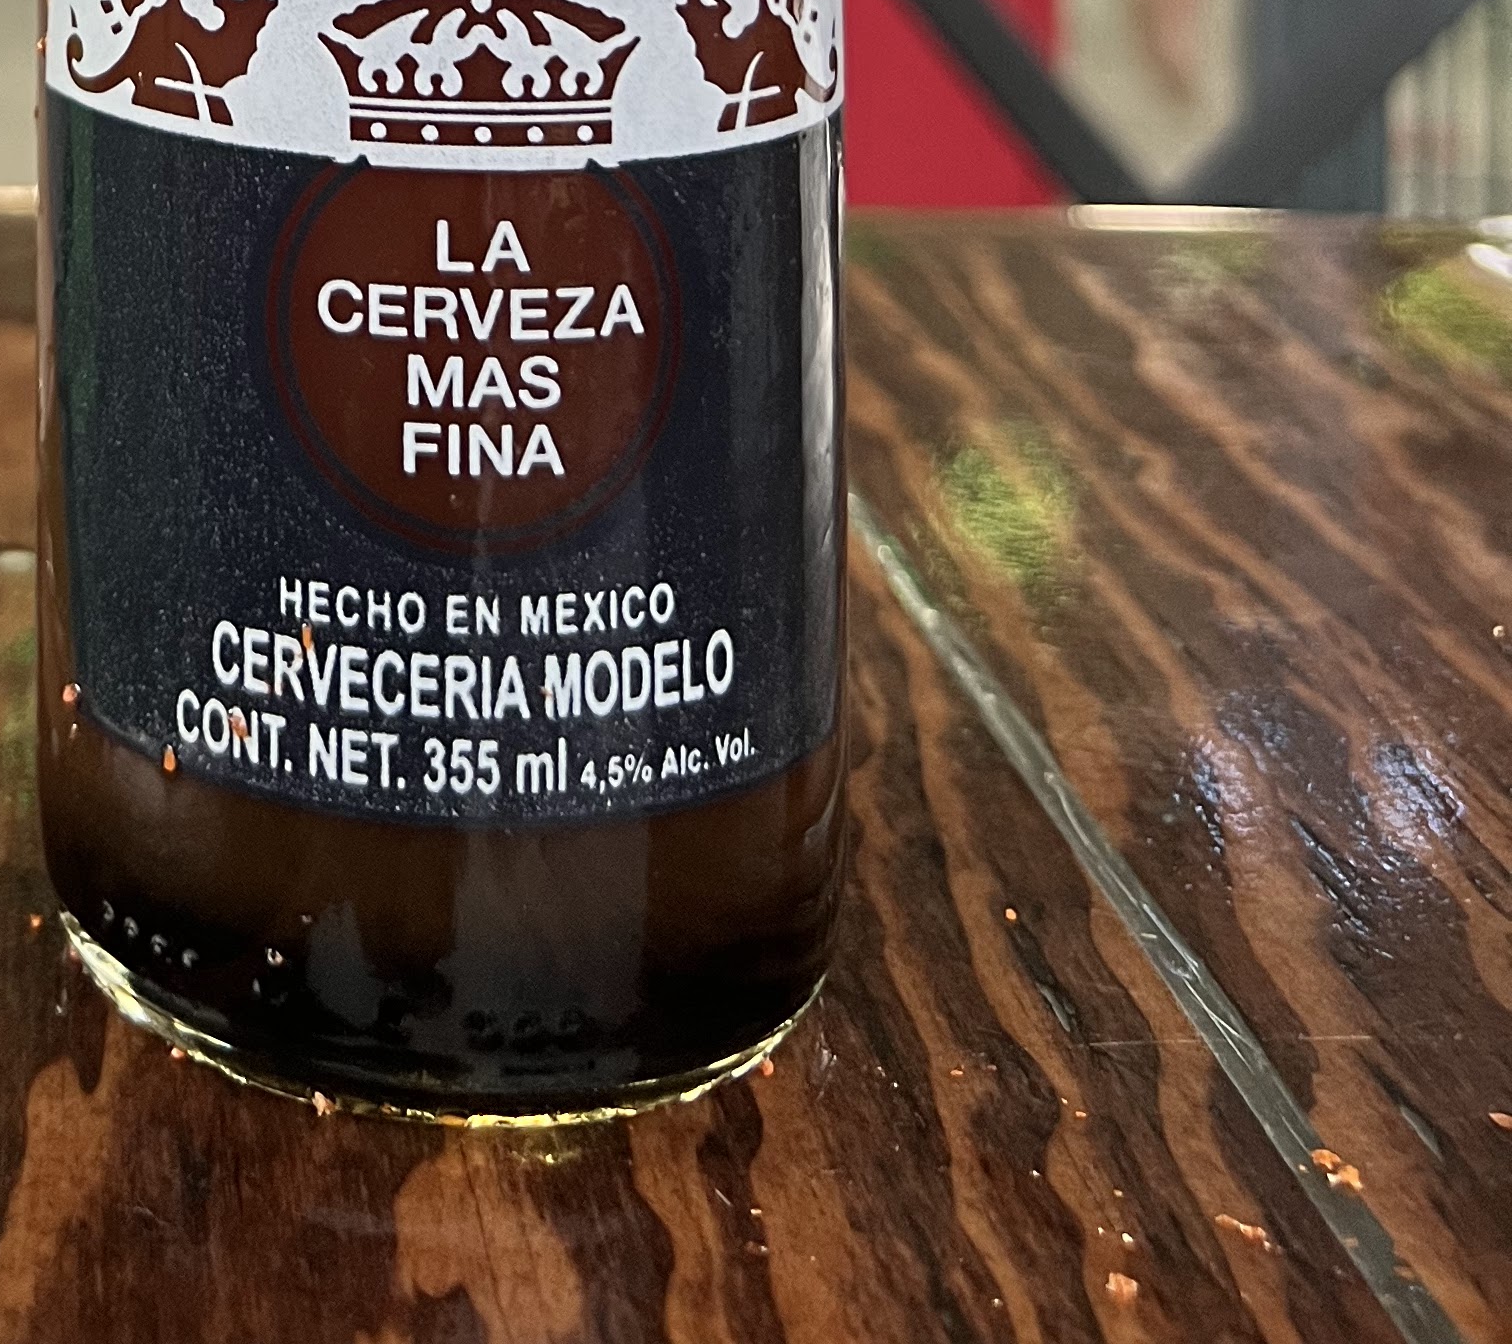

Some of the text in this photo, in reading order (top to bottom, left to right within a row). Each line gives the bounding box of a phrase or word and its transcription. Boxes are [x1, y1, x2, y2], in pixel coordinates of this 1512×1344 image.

[436, 218, 531, 273] LA
[317, 278, 646, 341] CERVEZA
[407, 352, 562, 409] MAS
[402, 421, 565, 477] FINA
[279, 575, 676, 636] HECHO EN MEXICO
[211, 619, 734, 720] CERVECERIA MODELO
[176, 688, 756, 795] CONT. NET. 355 ml 4,5% Alc. Vol.
